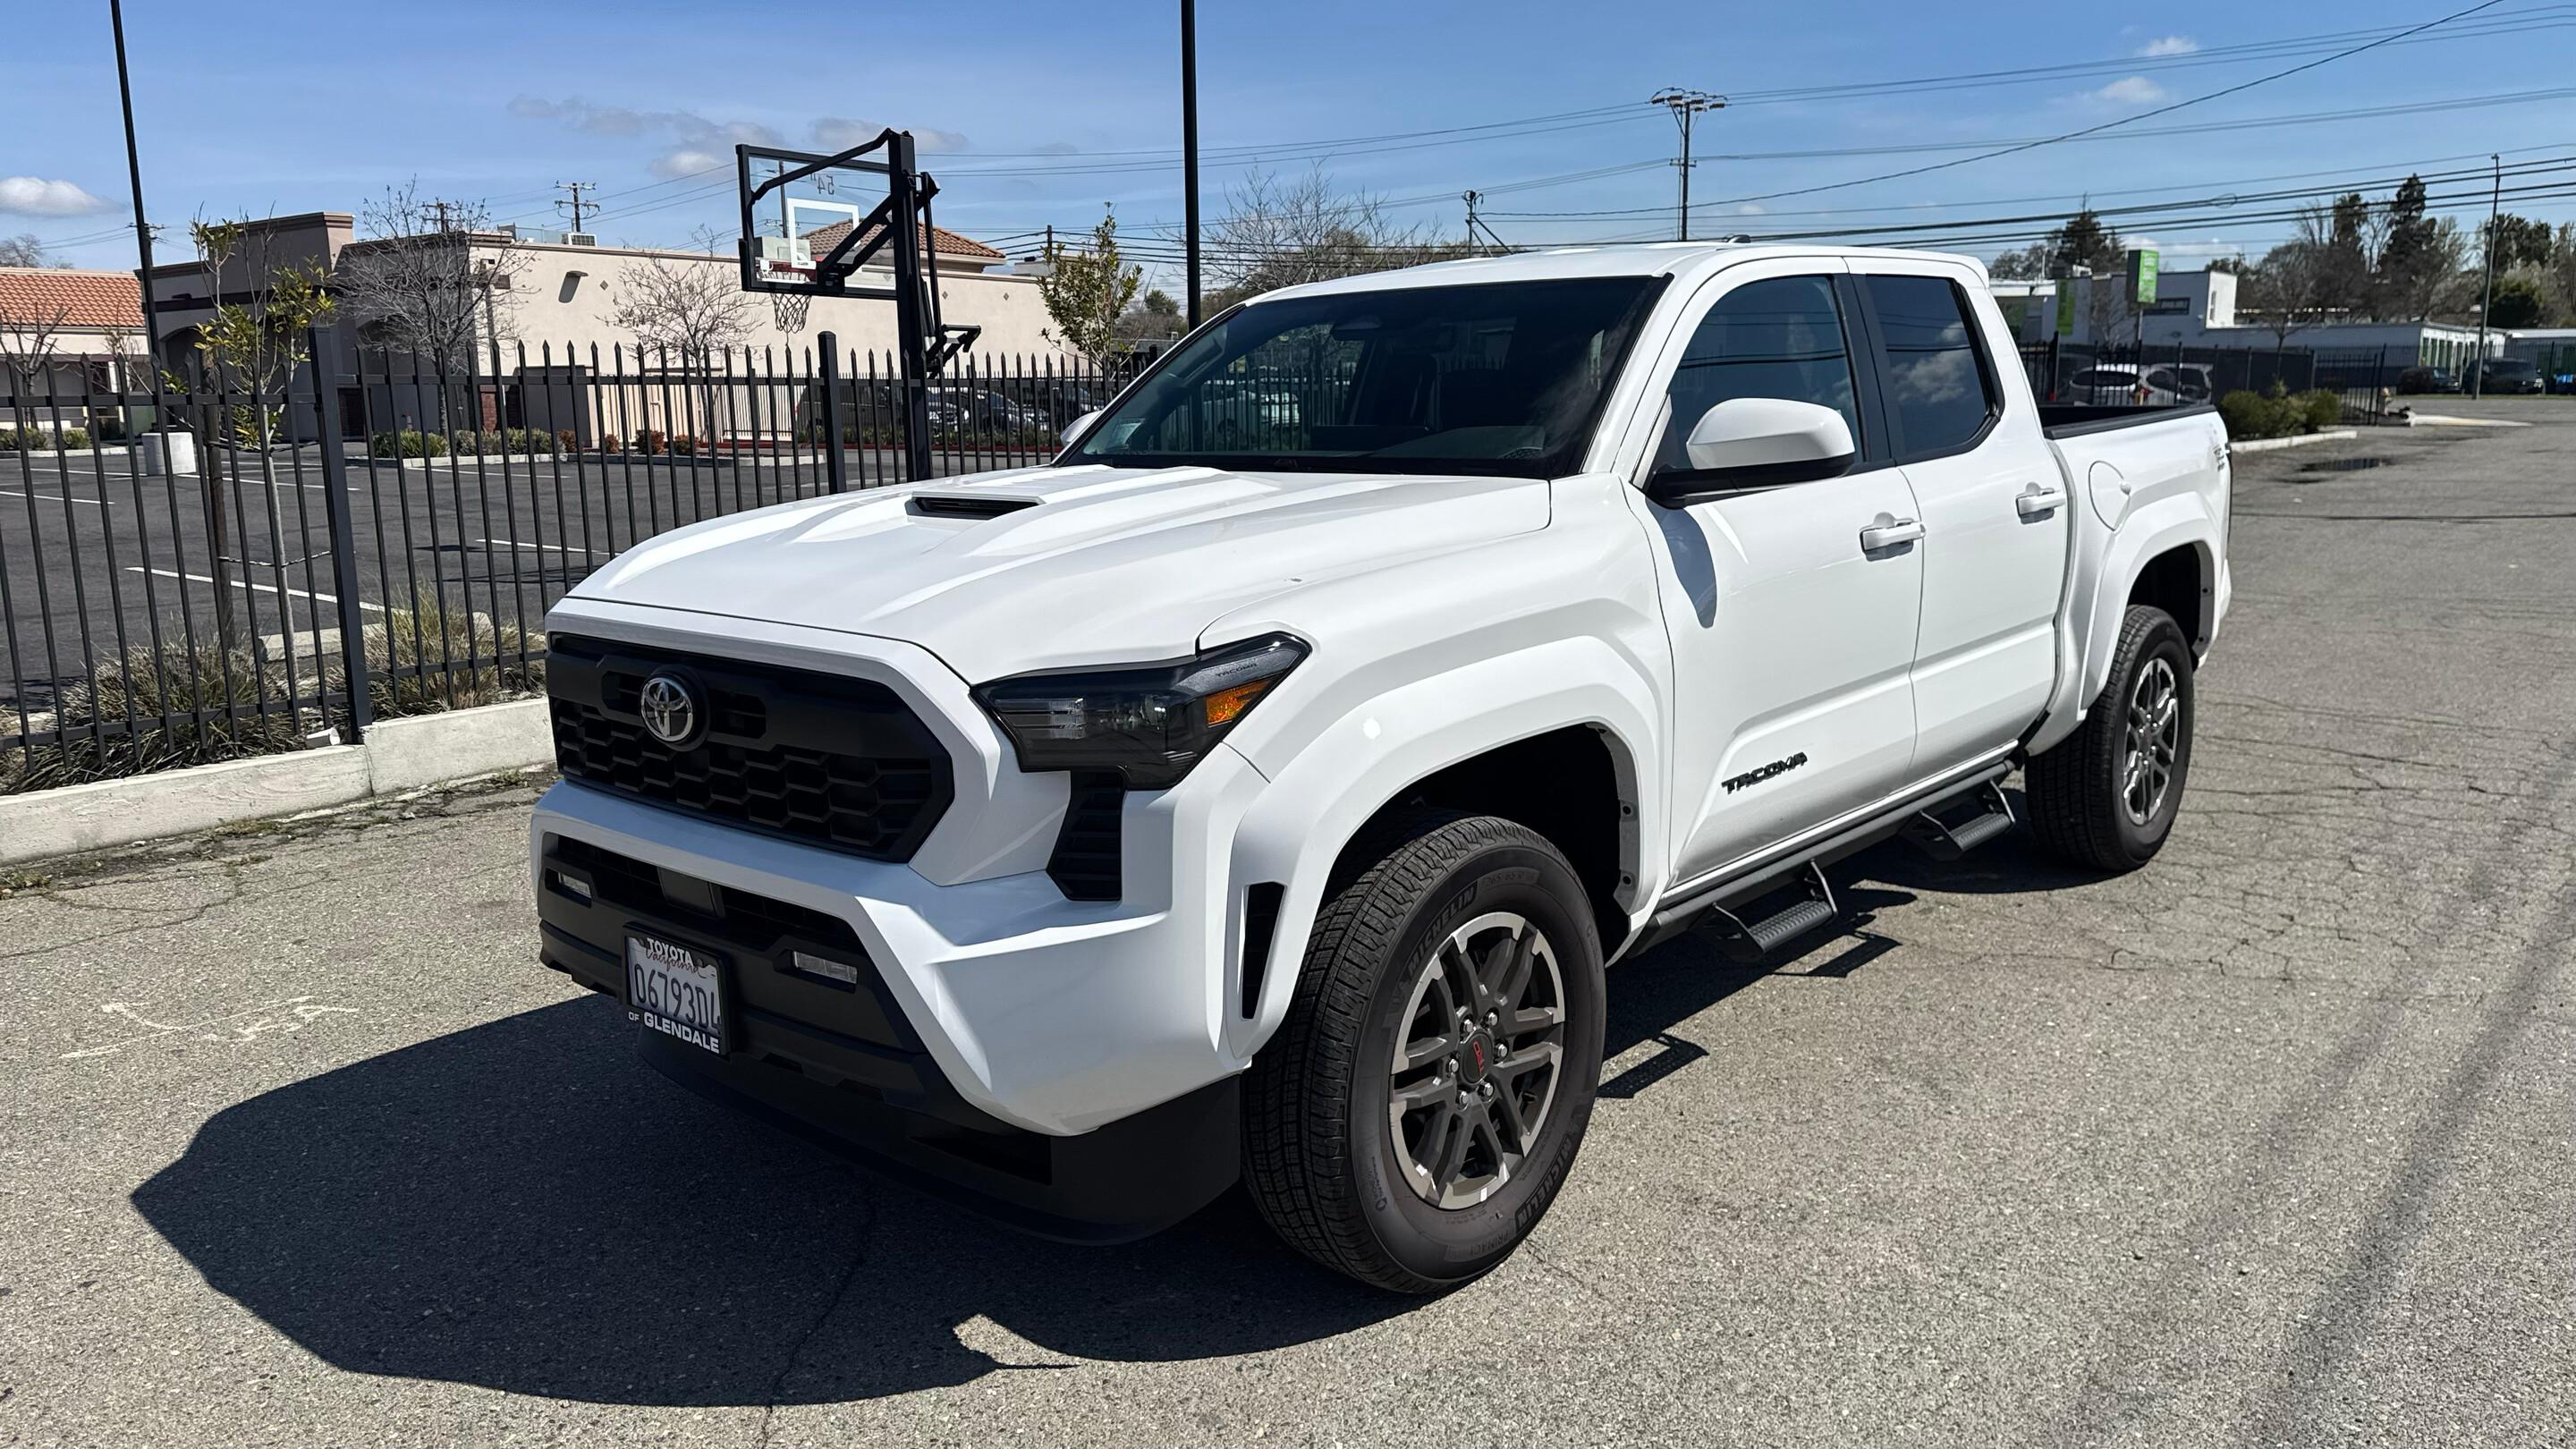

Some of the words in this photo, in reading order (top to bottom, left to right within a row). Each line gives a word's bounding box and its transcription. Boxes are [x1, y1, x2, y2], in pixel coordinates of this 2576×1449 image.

[1216, 663, 1258, 677] TACOMA
[1721, 751, 1808, 795] TACOMA
[647, 937, 694, 965] TOYOTA
[1408, 886, 1474, 975] MICHELIN
[628, 1012, 640, 1021] OF
[644, 1012, 719, 1054] GLENDALE
[1518, 1137, 1572, 1226] MICHELIN
